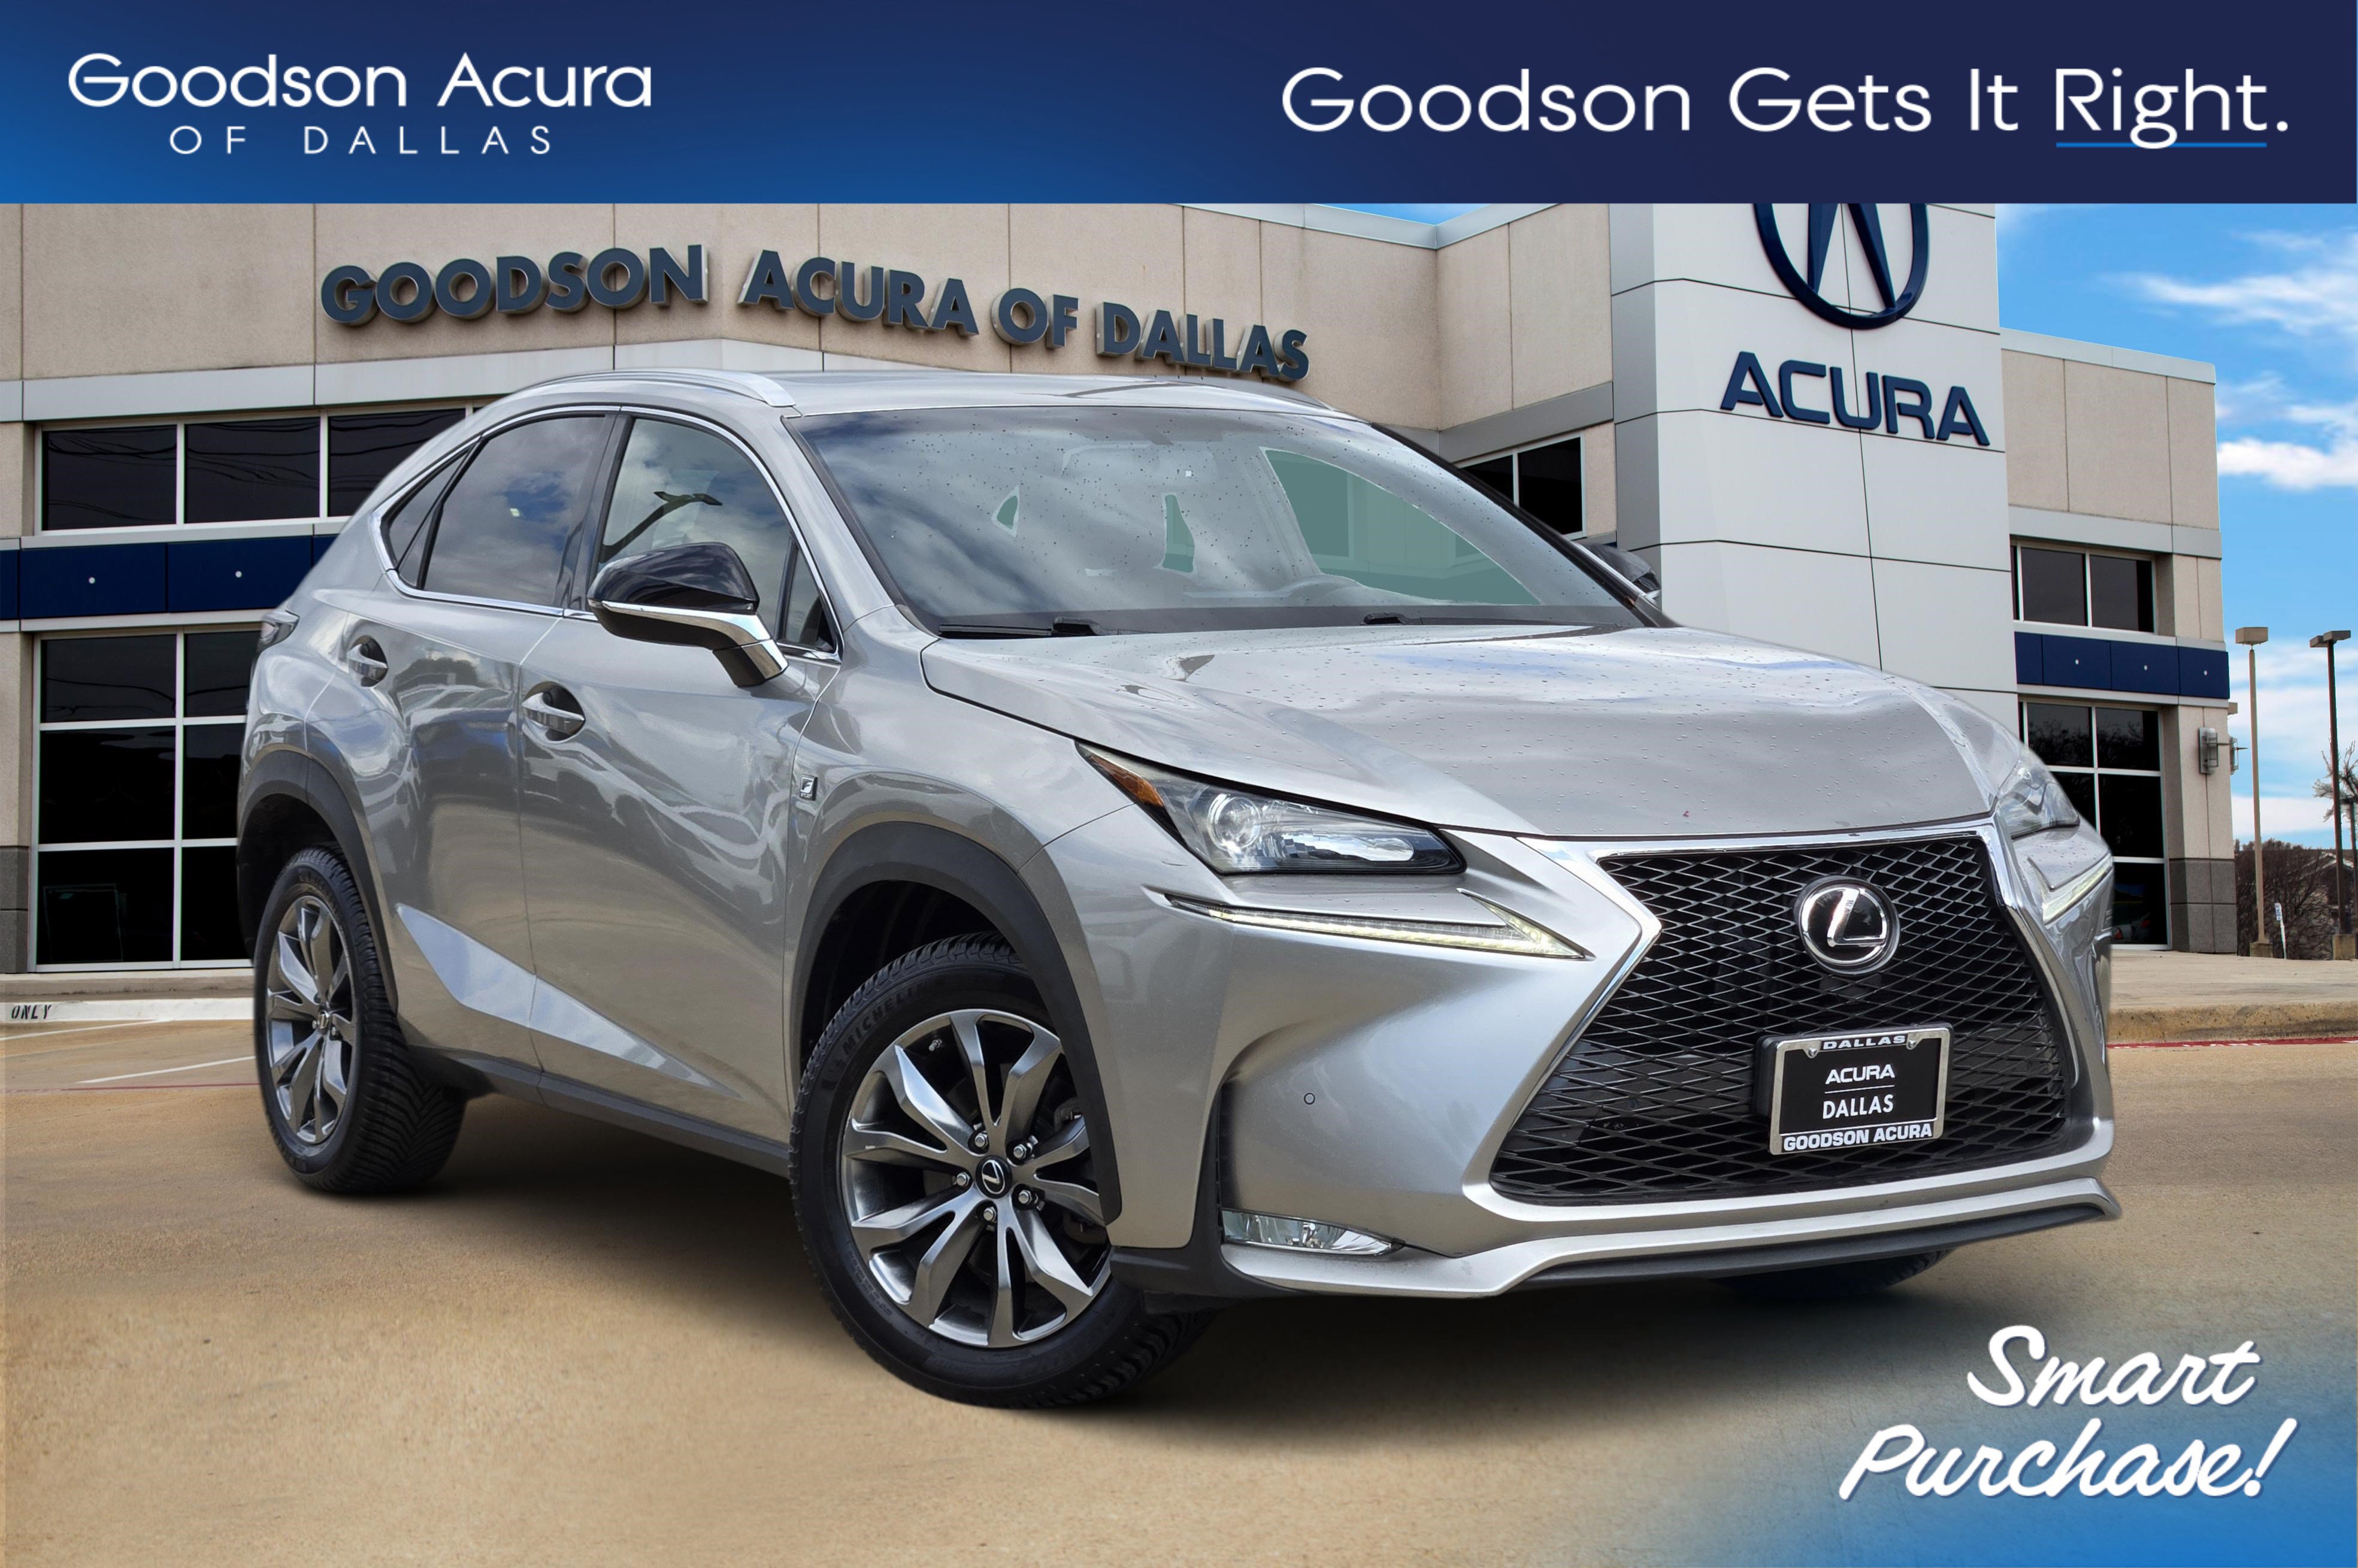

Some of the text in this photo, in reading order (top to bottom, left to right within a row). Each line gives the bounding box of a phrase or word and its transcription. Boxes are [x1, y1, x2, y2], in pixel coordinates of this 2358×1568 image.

[320, 244, 1310, 382] GOODSON ACURA OF DALLAS
[1720, 351, 1990, 446] ACURA
[11, 1004, 52, 1019] ONLY
[1823, 1035, 1906, 1050] DALLAS
[1825, 1063, 1896, 1085] ACURA
[1823, 1094, 1894, 1119] DALLAS
[1783, 1122, 1932, 1152] GOODSON ACURA
